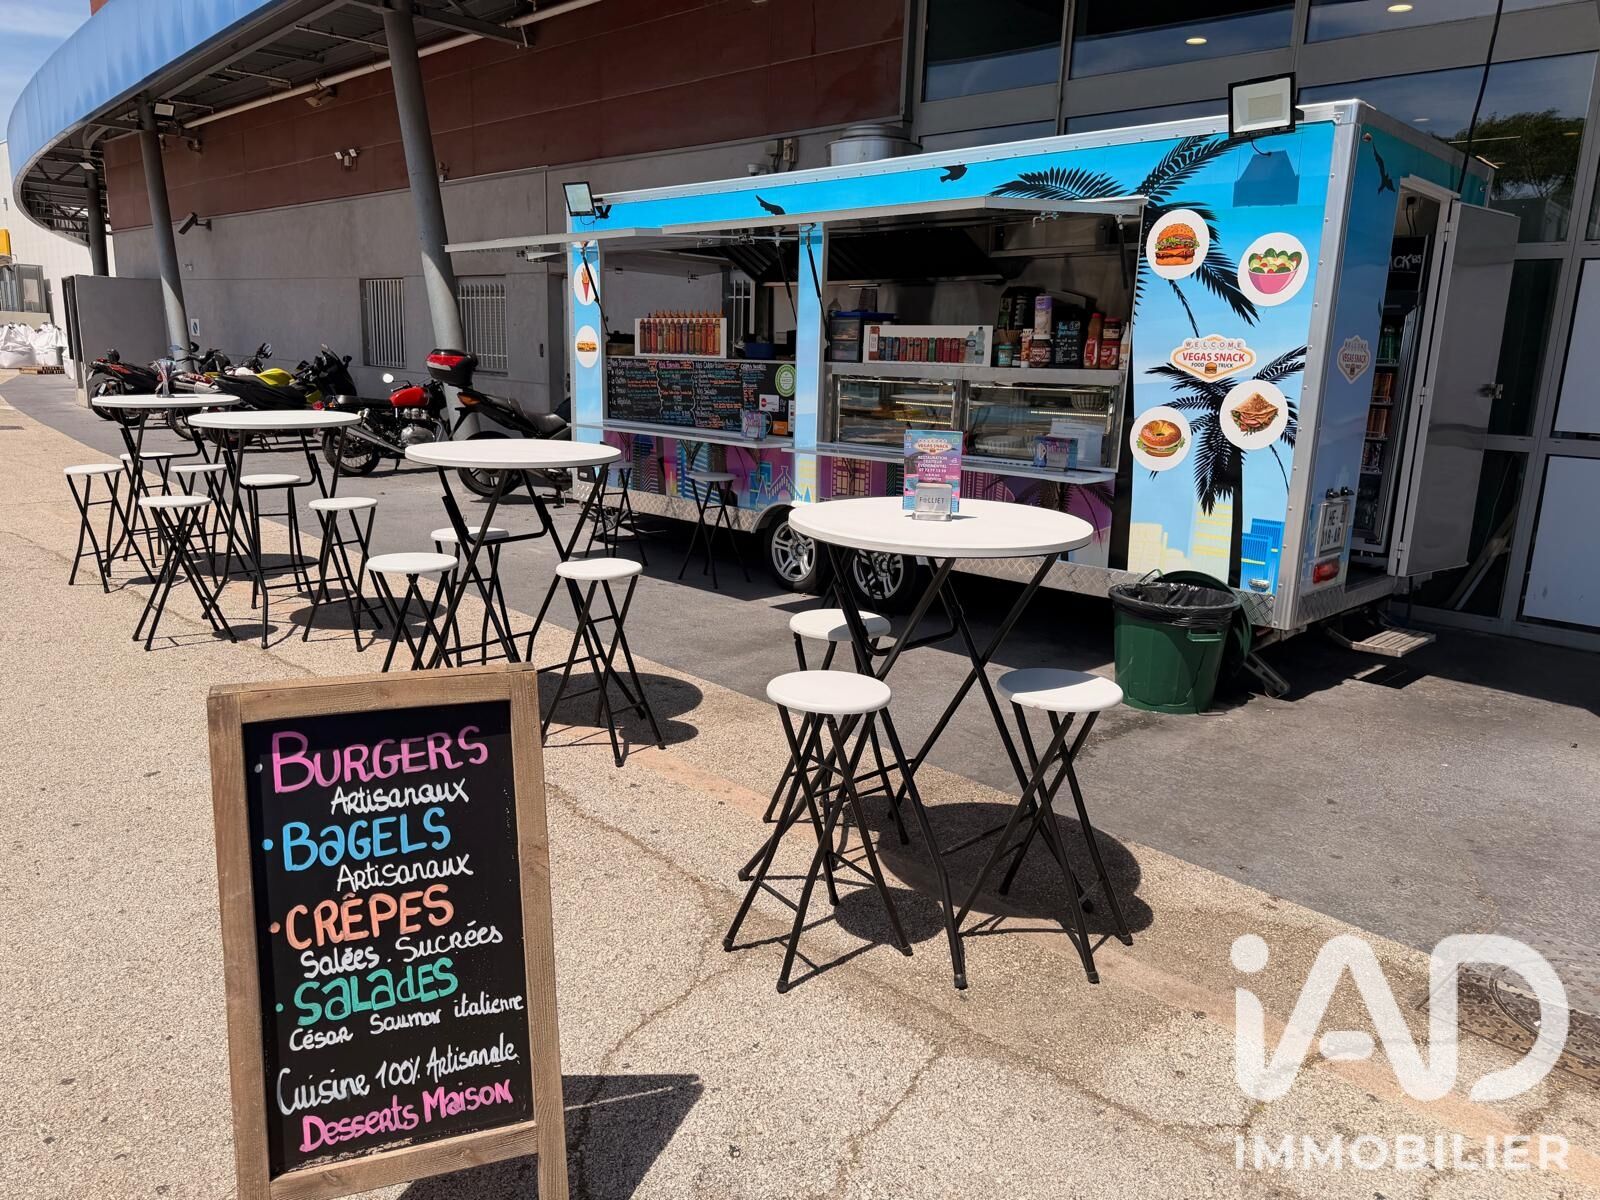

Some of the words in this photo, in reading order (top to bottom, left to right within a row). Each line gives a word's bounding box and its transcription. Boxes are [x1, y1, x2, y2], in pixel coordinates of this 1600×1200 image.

[1182, 353, 1212, 362] VEGAS
[1214, 353, 1245, 362] SNACK
[1185, 341, 1242, 349] WELCOME
[271, 725, 489, 793] BURGERS
[330, 778, 470, 816] Artisanaux
[336, 854, 474, 892] Artisanaux
[285, 884, 455, 950] CRÊPES
[300, 946, 380, 979] Salées
[394, 920, 504, 963] Sucrées
[276, 1067, 371, 1117] Cuisine
[299, 1094, 420, 1153] Desserts
